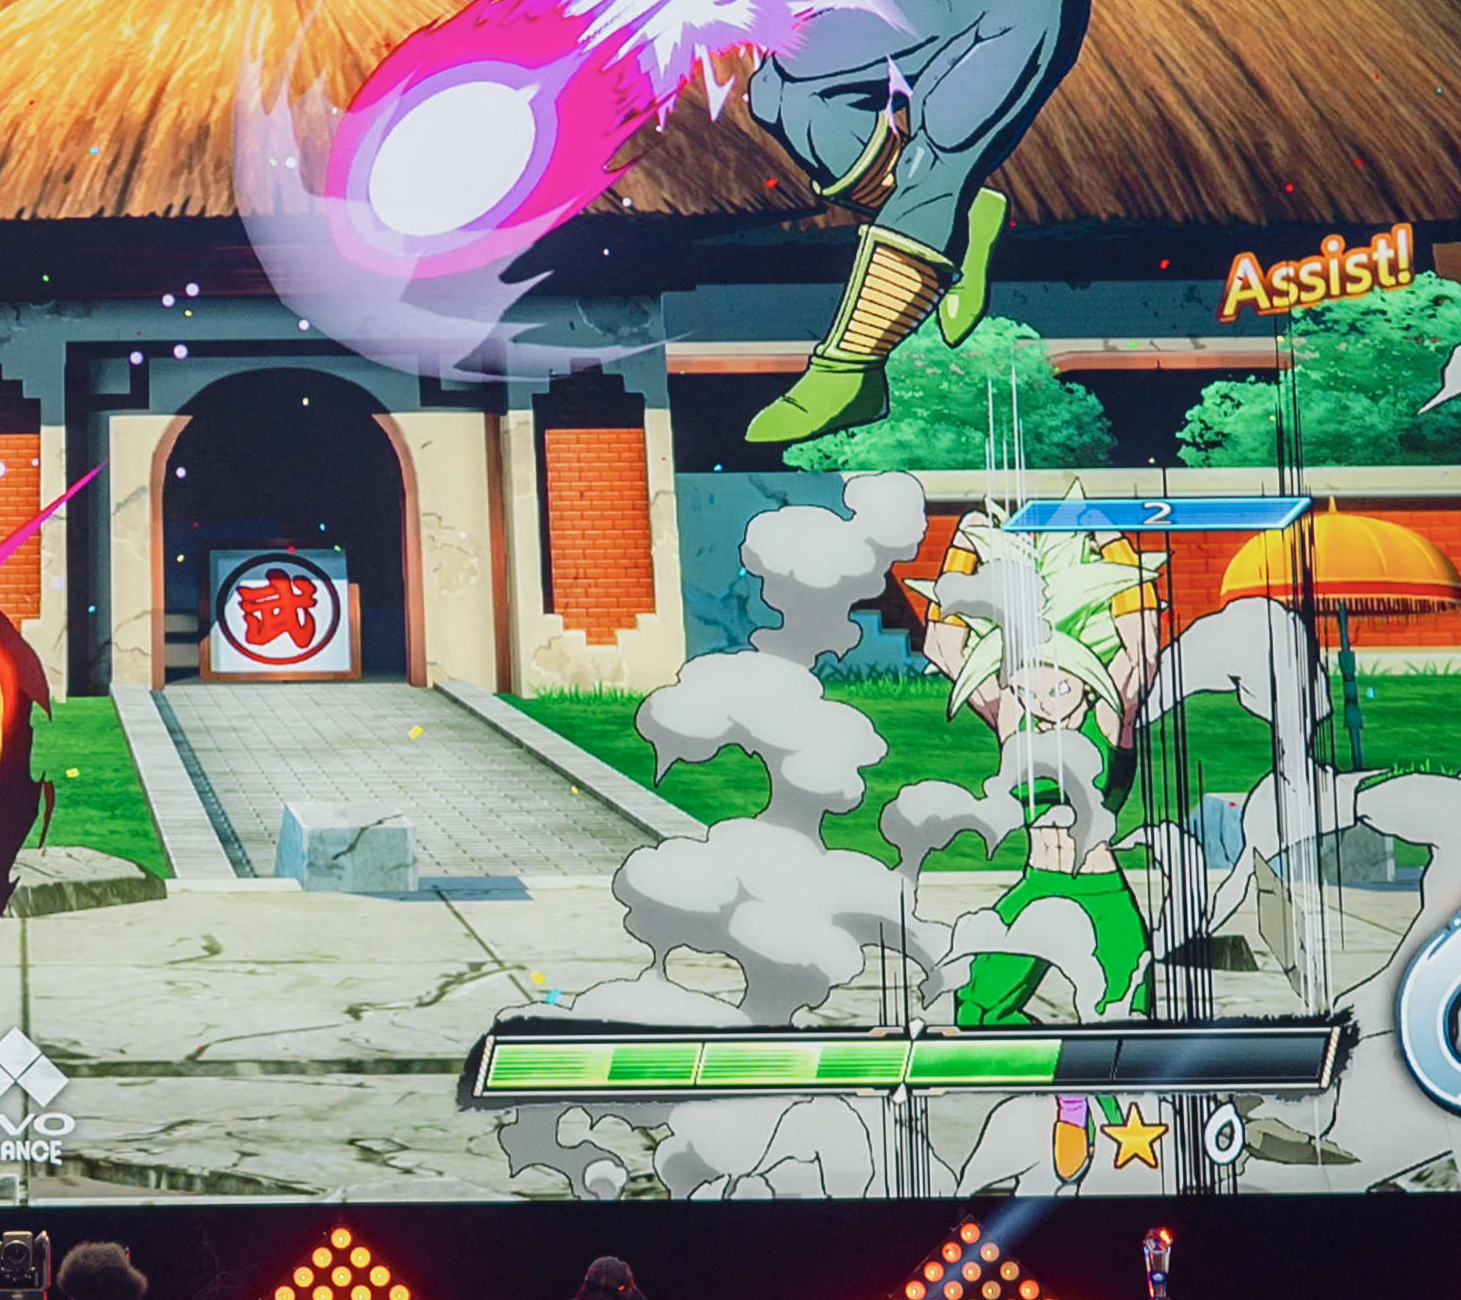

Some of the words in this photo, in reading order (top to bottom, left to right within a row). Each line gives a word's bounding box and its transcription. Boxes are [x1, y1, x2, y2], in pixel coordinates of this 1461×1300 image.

[1216, 223, 1414, 321] Assist!
[1142, 502, 1172, 523] 2
[235, 568, 318, 649] 武
[1204, 1103, 1244, 1165] 0
